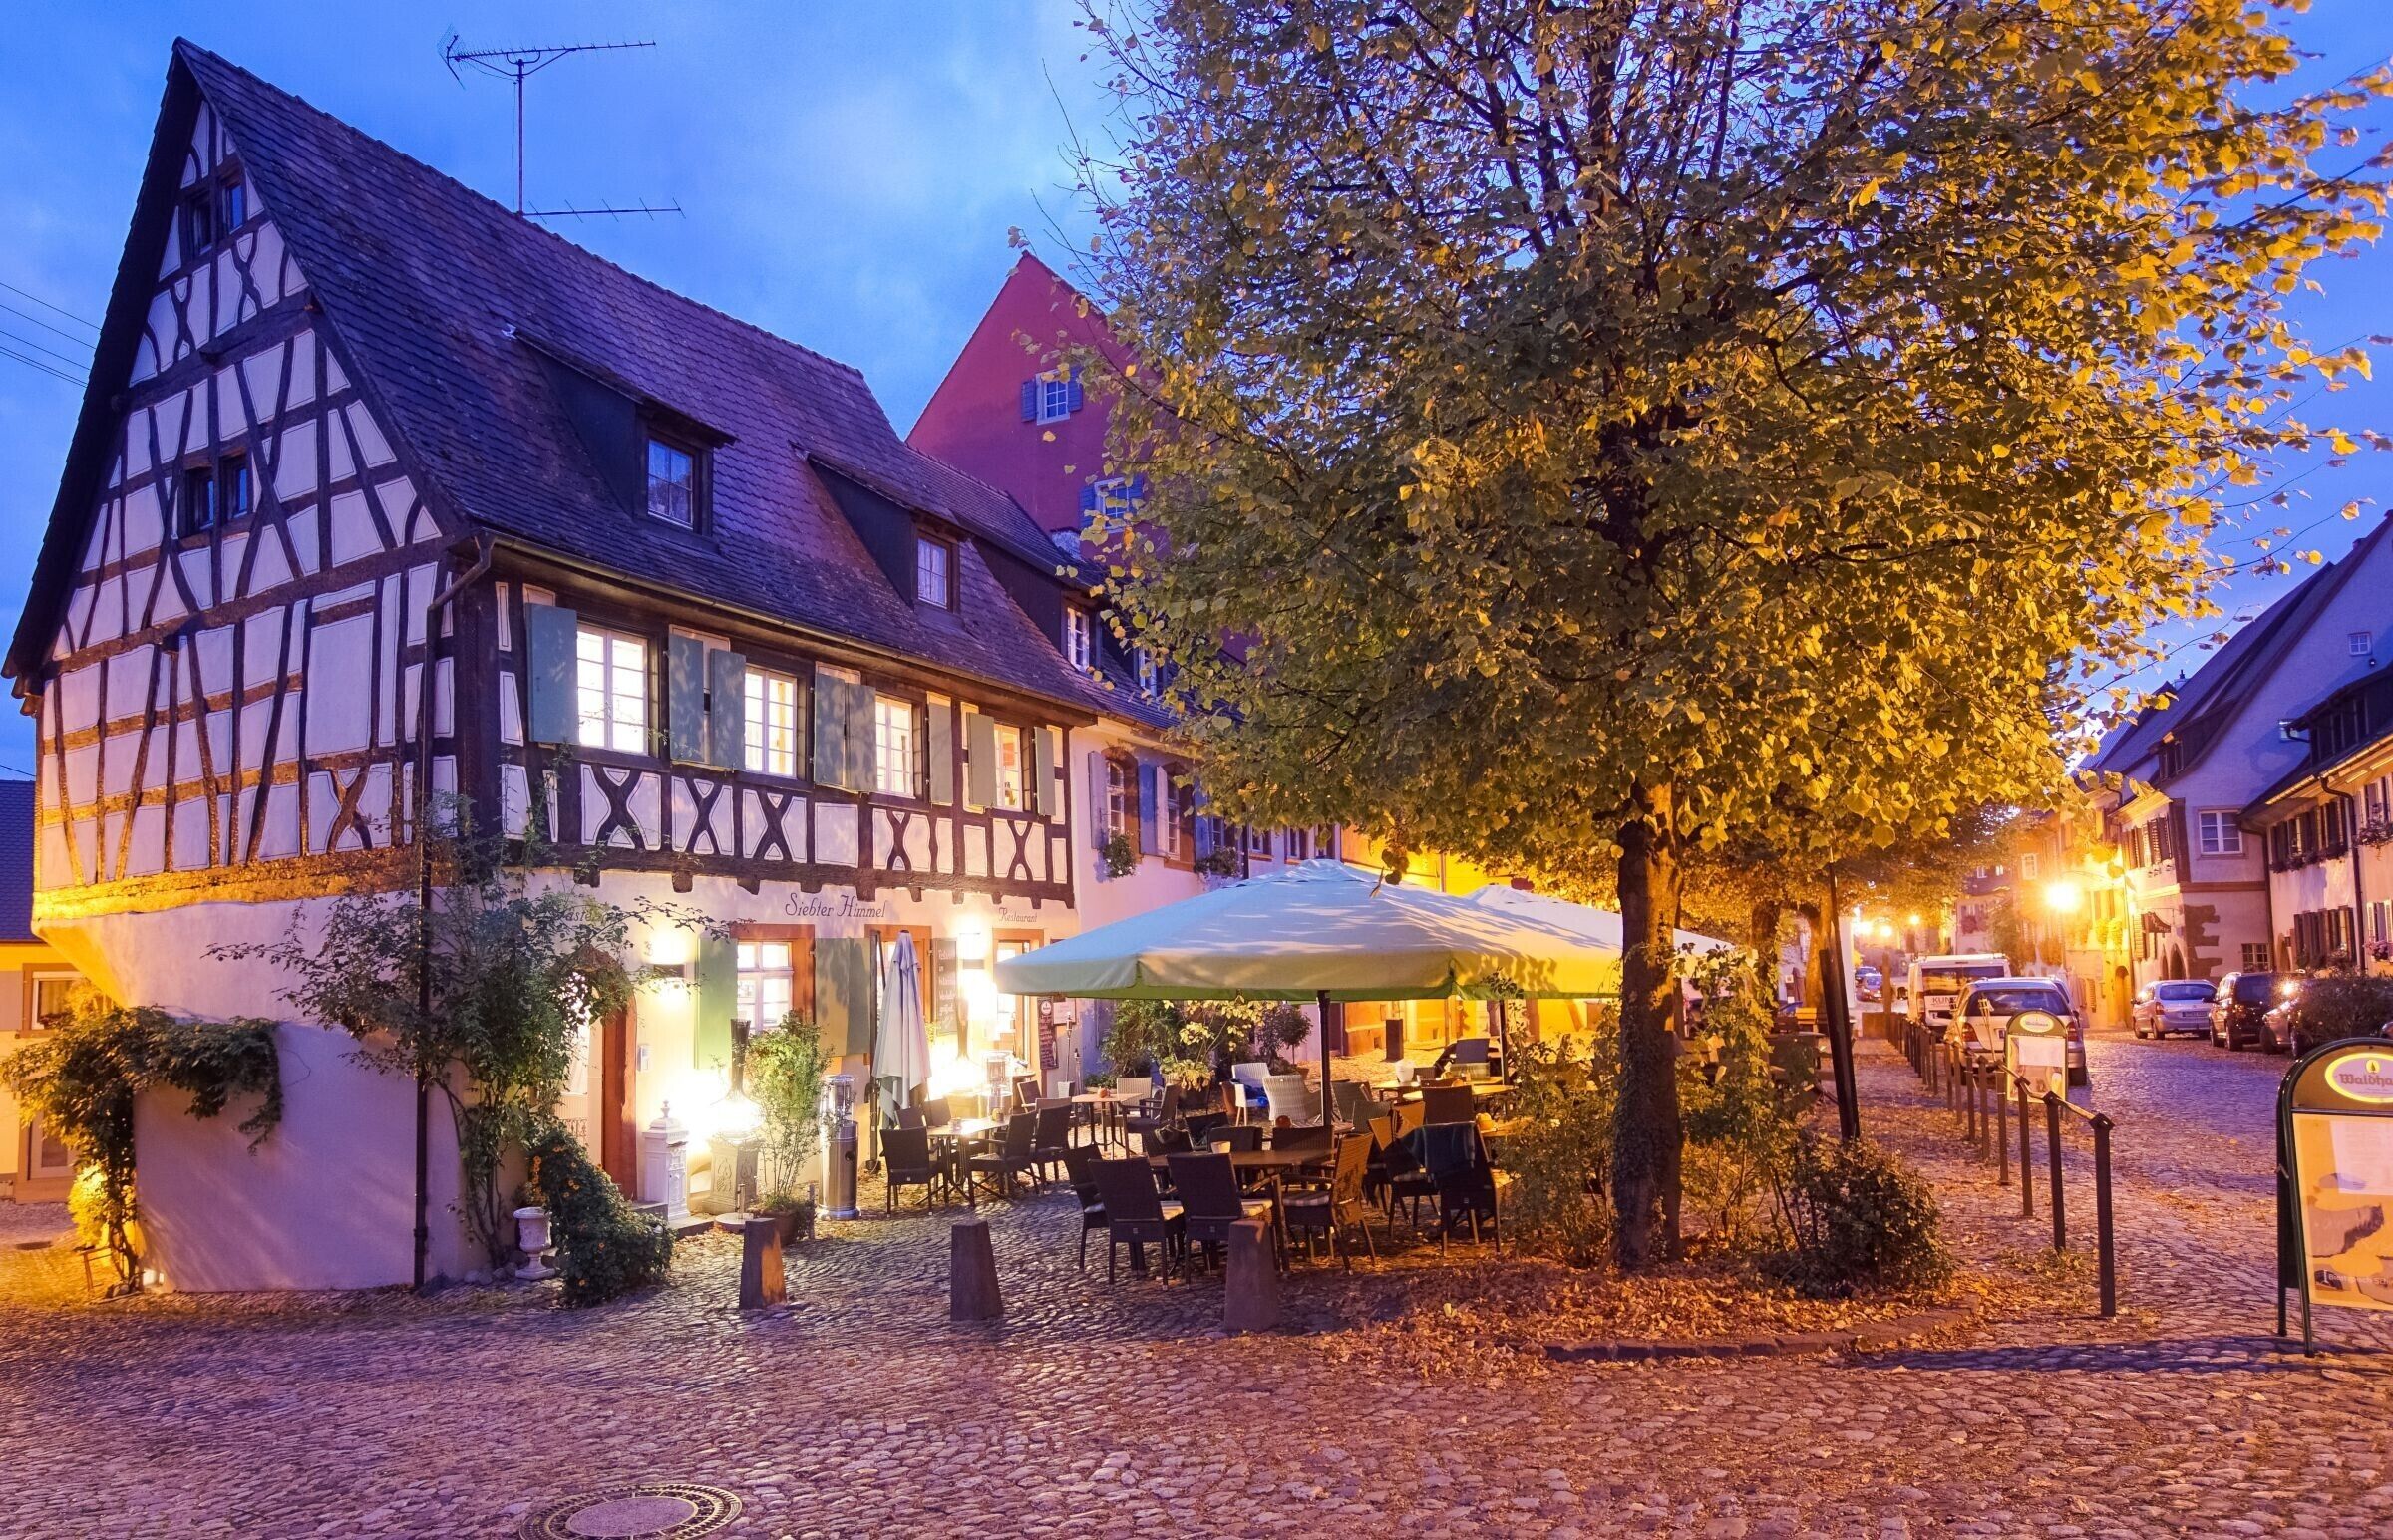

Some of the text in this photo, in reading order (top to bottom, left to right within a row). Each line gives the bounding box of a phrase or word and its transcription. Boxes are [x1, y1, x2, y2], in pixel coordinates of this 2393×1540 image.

[785, 892, 888, 918] Siebter Himmel
[998, 906, 1038, 923] Restaurant
